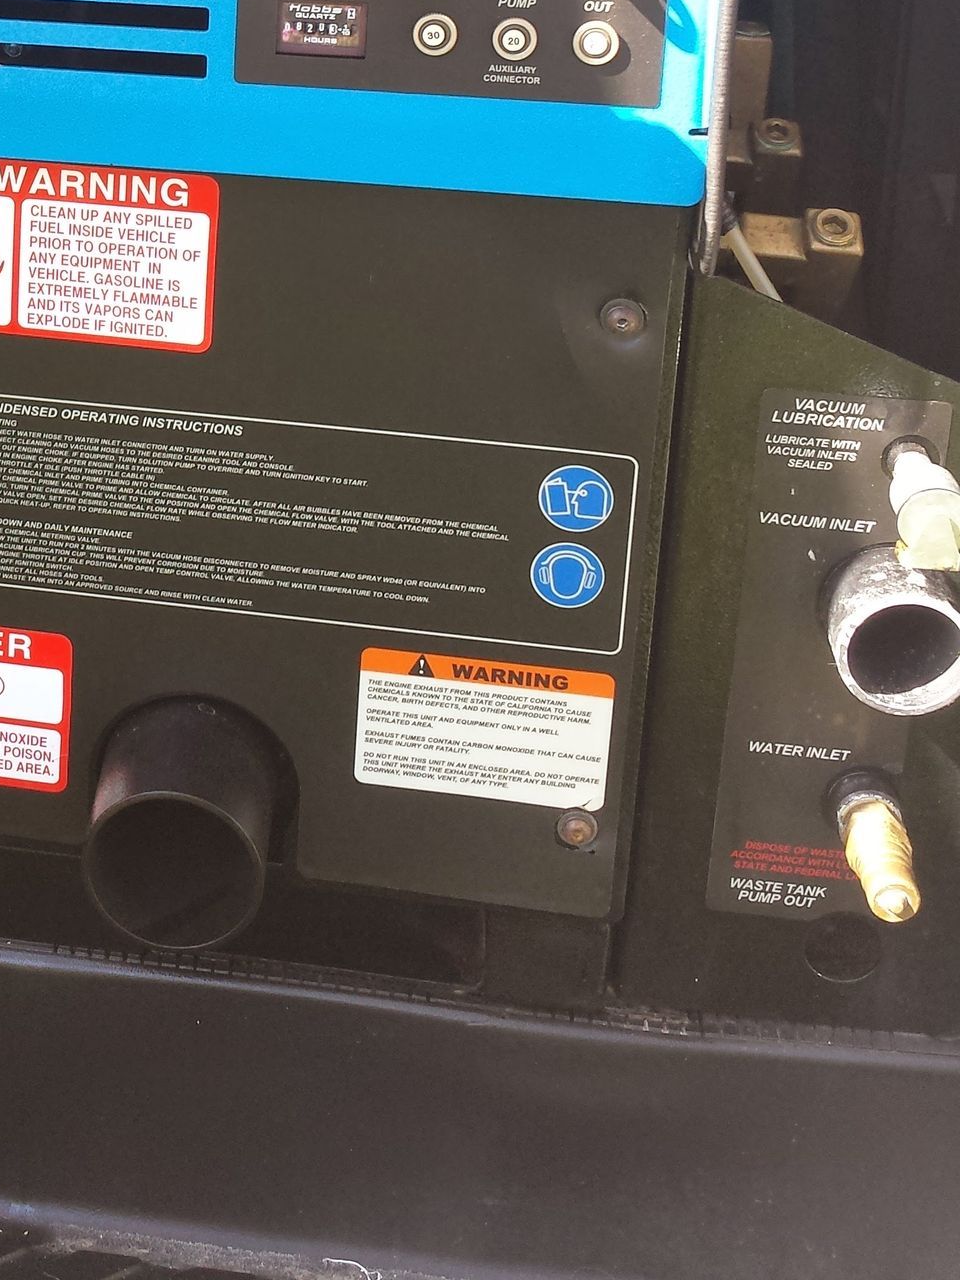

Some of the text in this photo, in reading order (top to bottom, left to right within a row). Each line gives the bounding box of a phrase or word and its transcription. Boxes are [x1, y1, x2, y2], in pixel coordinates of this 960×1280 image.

[289, 3, 343, 14] Hobbs
[582, 0, 615, 12] OUT
[295, 12, 336, 20] QUARTZ
[303, 36, 338, 45] HOURS
[427, 31, 440, 40] 30
[507, 37, 520, 46] 20
[488, 64, 536, 74] AUXILIARY
[483, 74, 540, 84] CONNECTOR
[30, 204, 192, 229] CLEAN UP ANY SPILLED
[29, 220, 175, 244] FUEL INSIDE VEHICLE
[29, 235, 200, 262] PRIOR TO OPERATION OF
[28, 250, 161, 274] ANY EQUIPMENT IN
[28, 266, 180, 292] VEHICLE. GASOLINE IS
[28, 281, 197, 309] EXTREMELY FLAMMABLE
[27, 297, 173, 322] AND ITS VAPORS CAN
[27, 312, 167, 337] EXPLODE IF IGNITED.
[795, 398, 865, 415] VACUUM
[61, 408, 139, 425] OPERATING
[142, 416, 243, 435] INSTRUCTIONS
[770, 410, 884, 431] LUBRICATION
[765, 433, 861, 450] LUBRICATE WITH
[767, 445, 858, 461] VACUUM INLETS
[787, 458, 833, 470] SEALED
[23, 520, 42, 529] AND
[43, 522, 70, 531] DAILY
[70, 525, 132, 539] MAINTENANCE
[760, 511, 877, 533] VACUUM INLET
[451, 663, 568, 690] WARNING
[3, 745, 54, 763] POISON.
[749, 740, 851, 760] WATER INLET
[16, 761, 54, 776] AREA.
[730, 877, 827, 897] WASTE TANK
[738, 890, 816, 907] PUMP OUT
